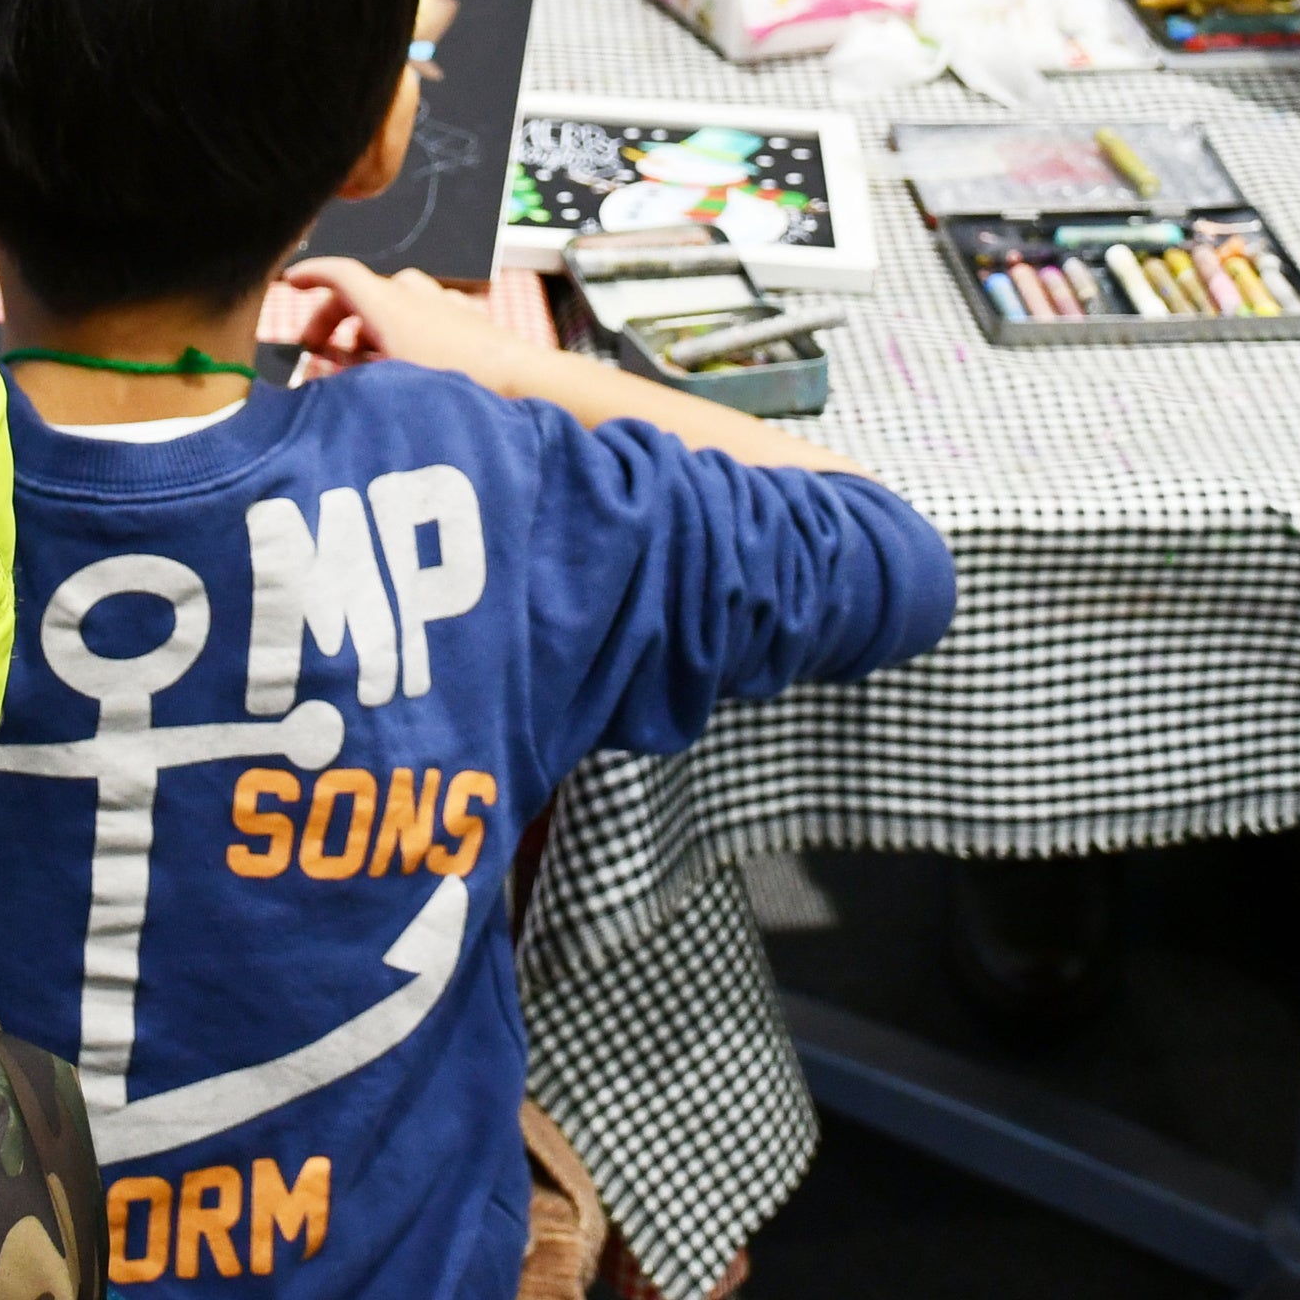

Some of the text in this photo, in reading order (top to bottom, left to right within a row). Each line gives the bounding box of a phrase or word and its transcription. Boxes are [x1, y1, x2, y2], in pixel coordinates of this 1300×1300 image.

[245, 464, 487, 716] MP
[227, 767, 497, 879] SONS
[107, 1156, 331, 1284] ORM
